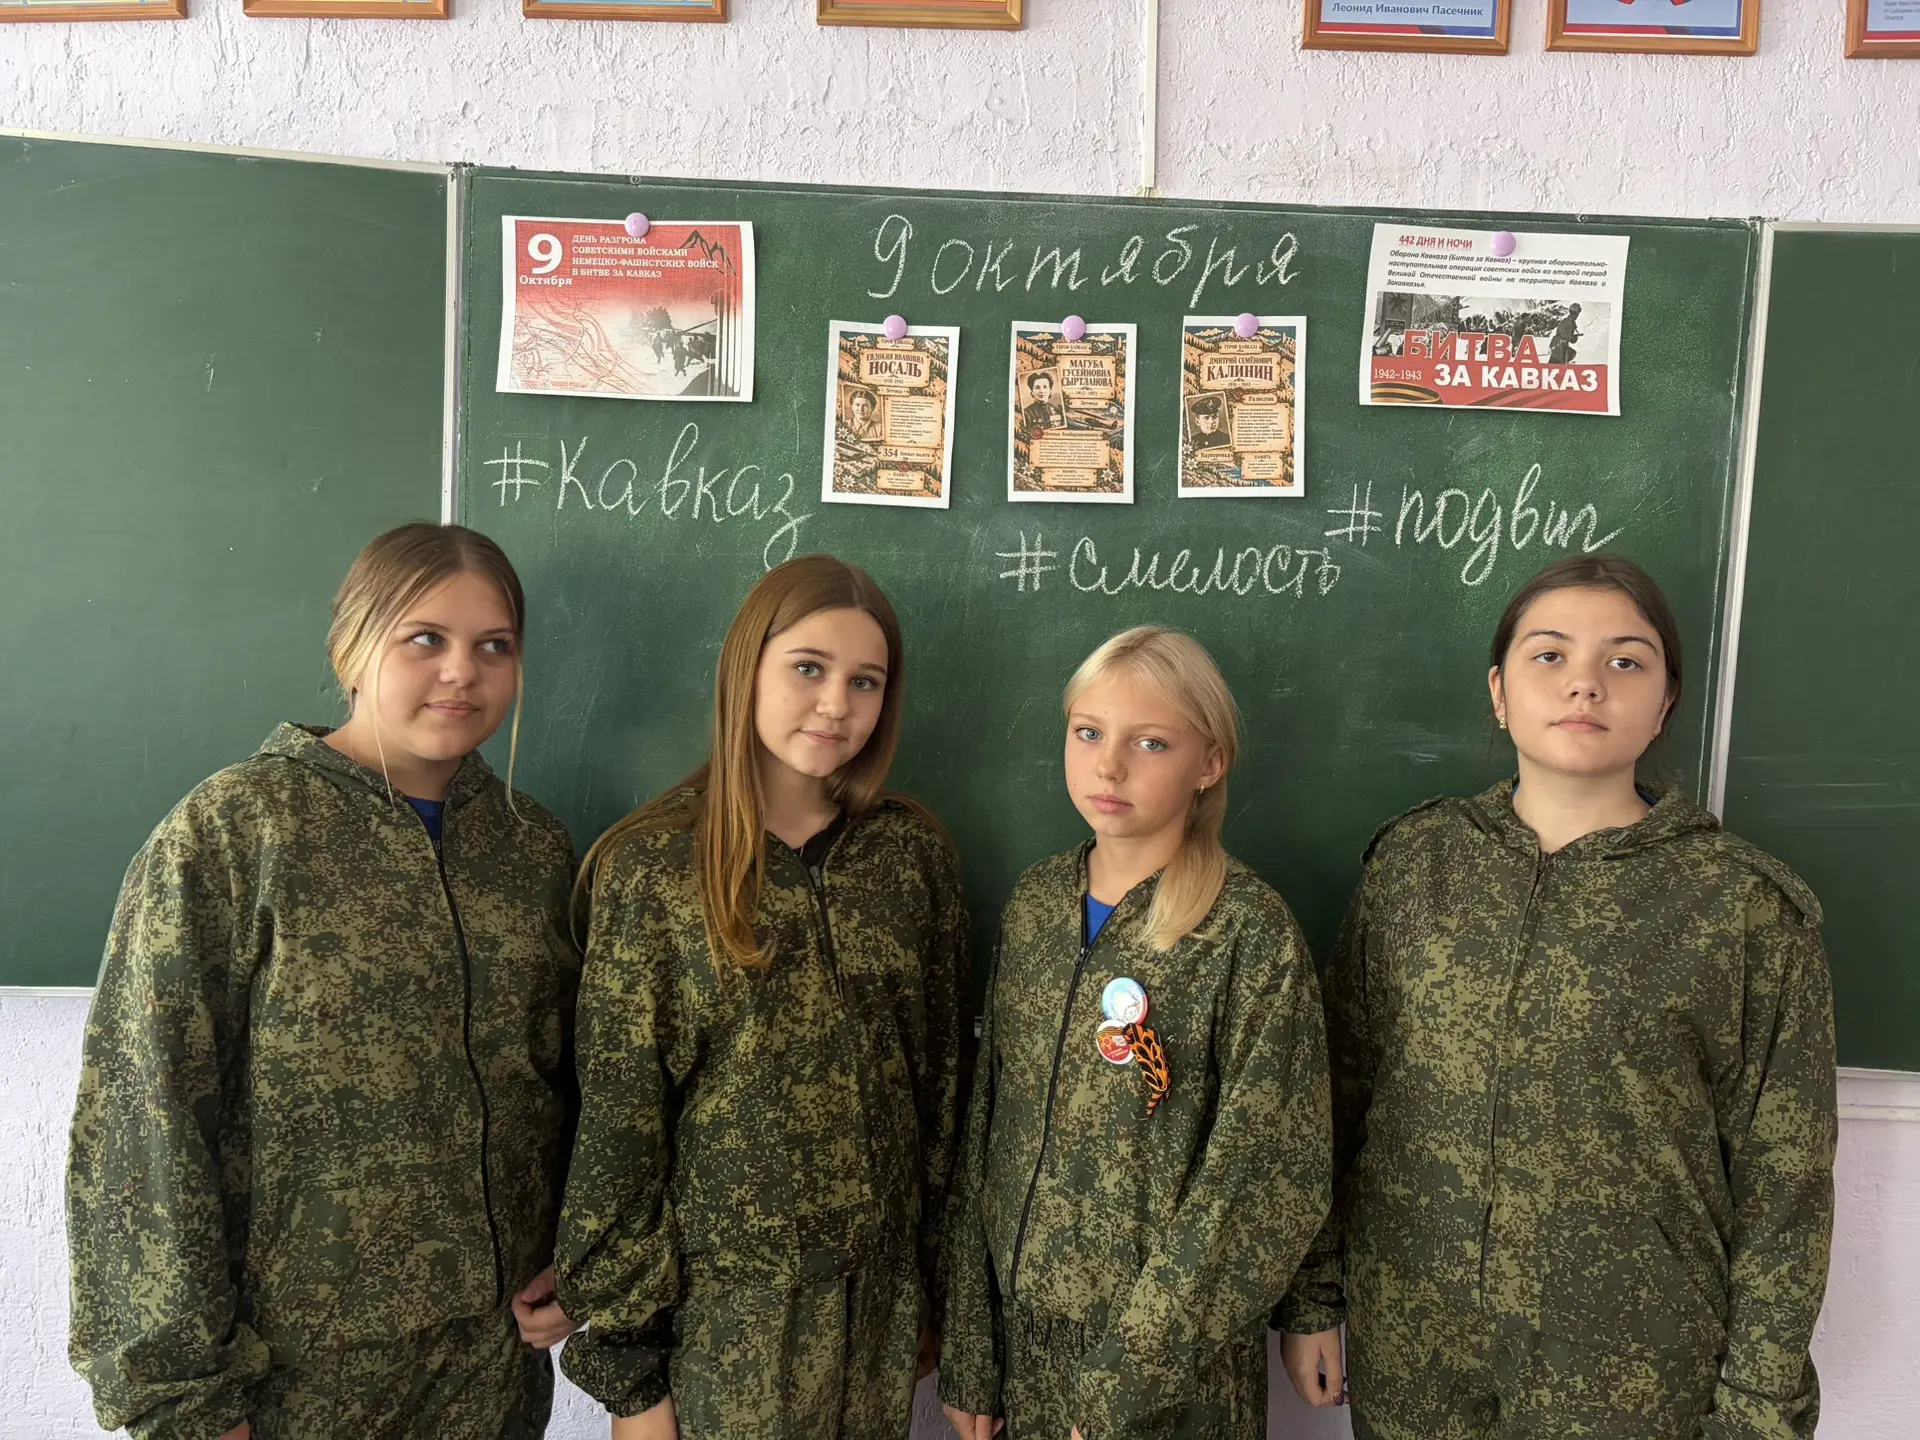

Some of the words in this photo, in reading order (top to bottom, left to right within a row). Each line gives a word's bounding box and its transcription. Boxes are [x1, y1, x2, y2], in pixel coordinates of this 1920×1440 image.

[1332, 3, 1372, 14] Леонид
[1375, 4, 1429, 14] Иванович
[1432, 6, 1483, 16] Пасечник
[572, 235, 598, 245] ДЕНЬ
[600, 236, 646, 245] РАЗГРОМА
[1399, 235, 1415, 245] 442
[1416, 236, 1436, 247] ДНЯ
[1438, 238, 1445, 247] И
[1447, 238, 1473, 249] НОЧИ
[527, 233, 563, 275] 9
[572, 246, 634, 256] СОВЕТСКИМИ
[637, 247, 688, 257] ВОЙСКАМИ
[572, 258, 685, 268] НЕМЕЦКО-ФАШИСТСКИХ
[688, 259, 718, 268] ВОЙСК
[867, 213, 913, 299] 9
[931, 224, 1301, 309] октября
[1390, 250, 1419, 258] Оборона
[1421, 252, 1448, 260] Кавказа
[1449, 254, 1474, 262] (Битва
[1485, 256, 1512, 264] Кавказ)
[1548, 259, 1608, 267] оборонительно-
[572, 268, 578, 276] В
[580, 269, 610, 277] БИТВЕ
[612, 269, 624, 277] ЗА
[626, 270, 662, 278] КАВКАЗ
[1389, 261, 1447, 270] наступательная
[1483, 266, 1520, 274] советских
[1581, 270, 1607, 278] период
[519, 276, 573, 288] Октября
[1386, 279, 1426, 288] Закавказья.
[1388, 270, 1416, 278] Великой
[1420, 272, 1476, 281] Отечественной
[1480, 275, 1502, 283] войны
[1519, 277, 1565, 285] территории
[1403, 329, 1540, 363] БИТВА
[866, 353, 893, 361] ЕВДОКИЯ
[895, 354, 924, 364] ИВАНОВНА
[1070, 360, 1103, 368] МАГУБА
[1209, 356, 1237, 364] ДМИТРИЙ
[1239, 356, 1273, 364] СЕМЁНОВИЧ
[868, 361, 922, 377] НОСАЛЬ
[1063, 368, 1111, 377] ГУСЕЙНОВНА
[1207, 365, 1273, 381] КАЛИНИН
[1061, 377, 1113, 387] СЫРТЛАНОВА
[1433, 363, 1473, 388] ЗА
[1481, 366, 1598, 392] КАВКАЗ
[882, 448, 898, 457] 354
[483, 422, 814, 573] #Кавказ
